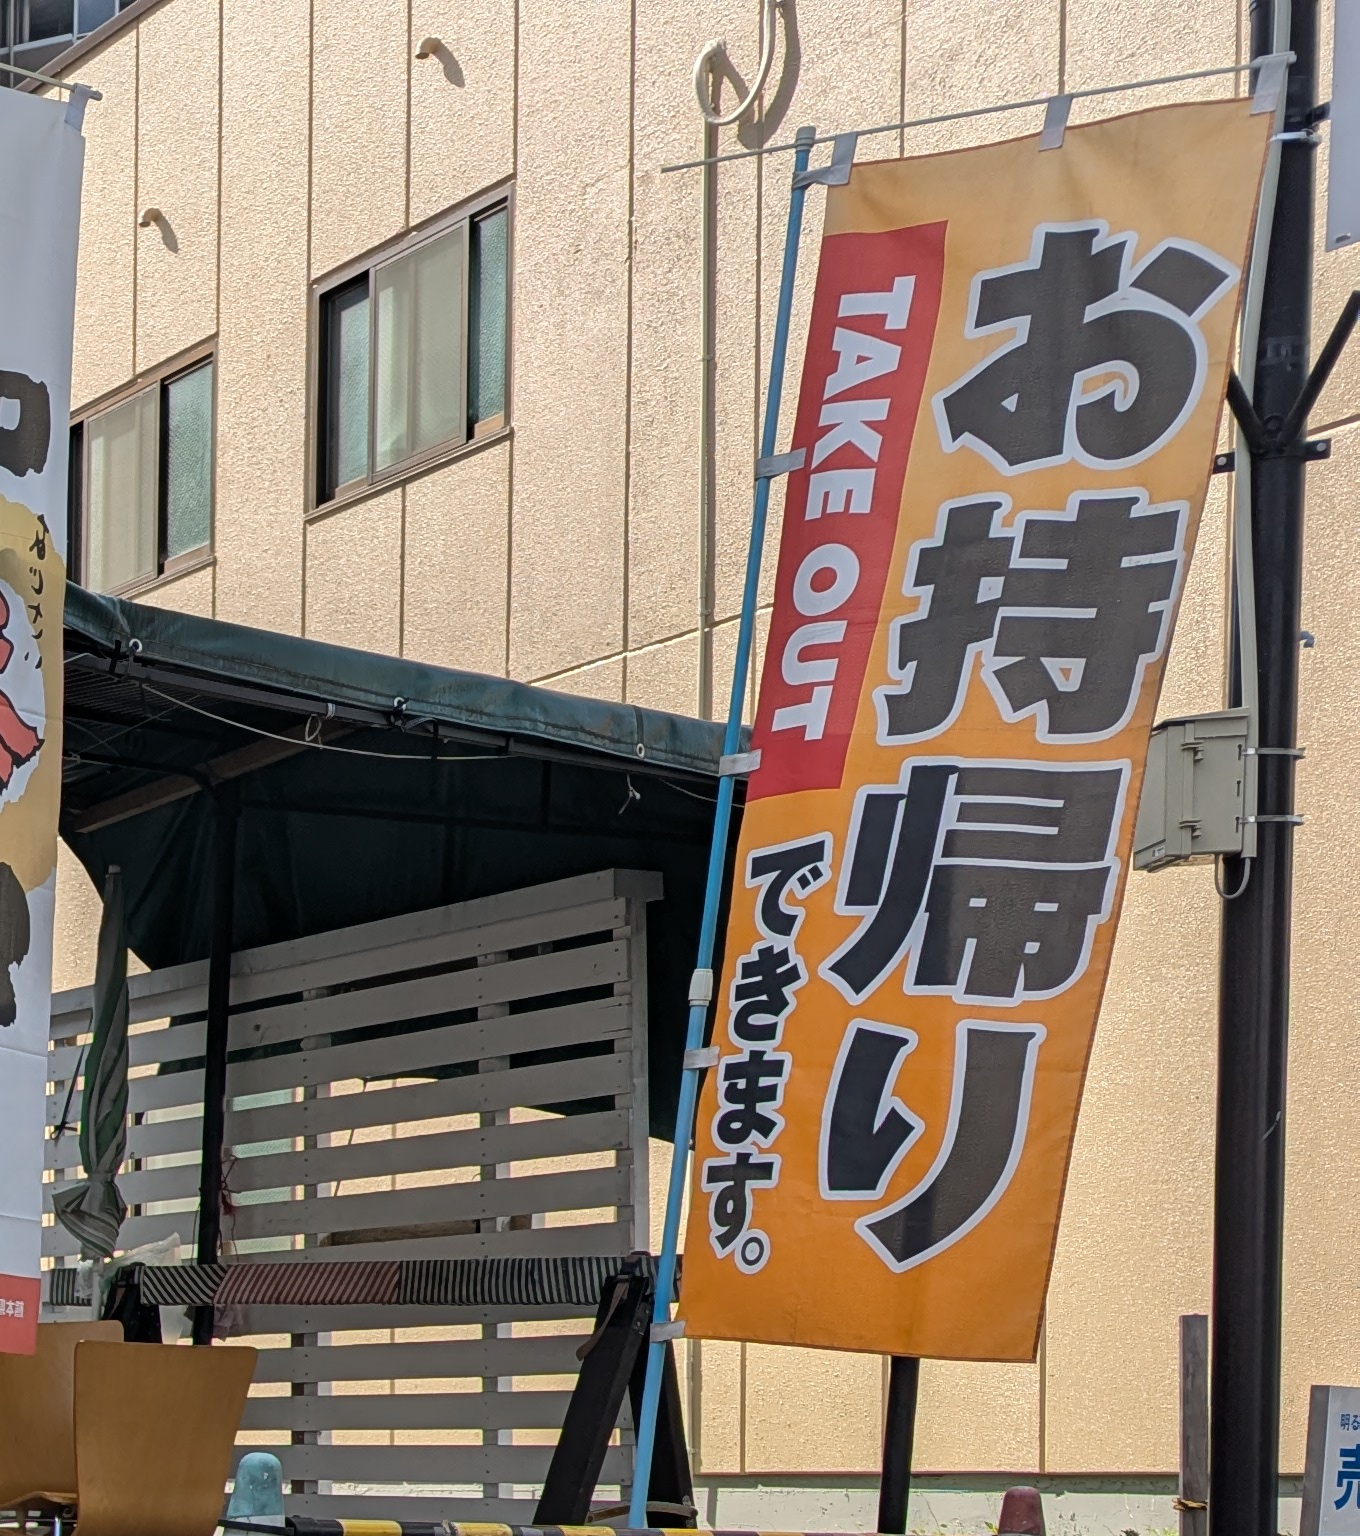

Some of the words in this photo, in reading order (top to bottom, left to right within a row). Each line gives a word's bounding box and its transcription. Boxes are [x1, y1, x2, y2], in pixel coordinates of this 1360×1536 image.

[804, 275, 916, 522] TAKE
[771, 543, 861, 742] OUT
[818, 219, 1242, 1273] お持帰り
[702, 831, 834, 1274] できます。
